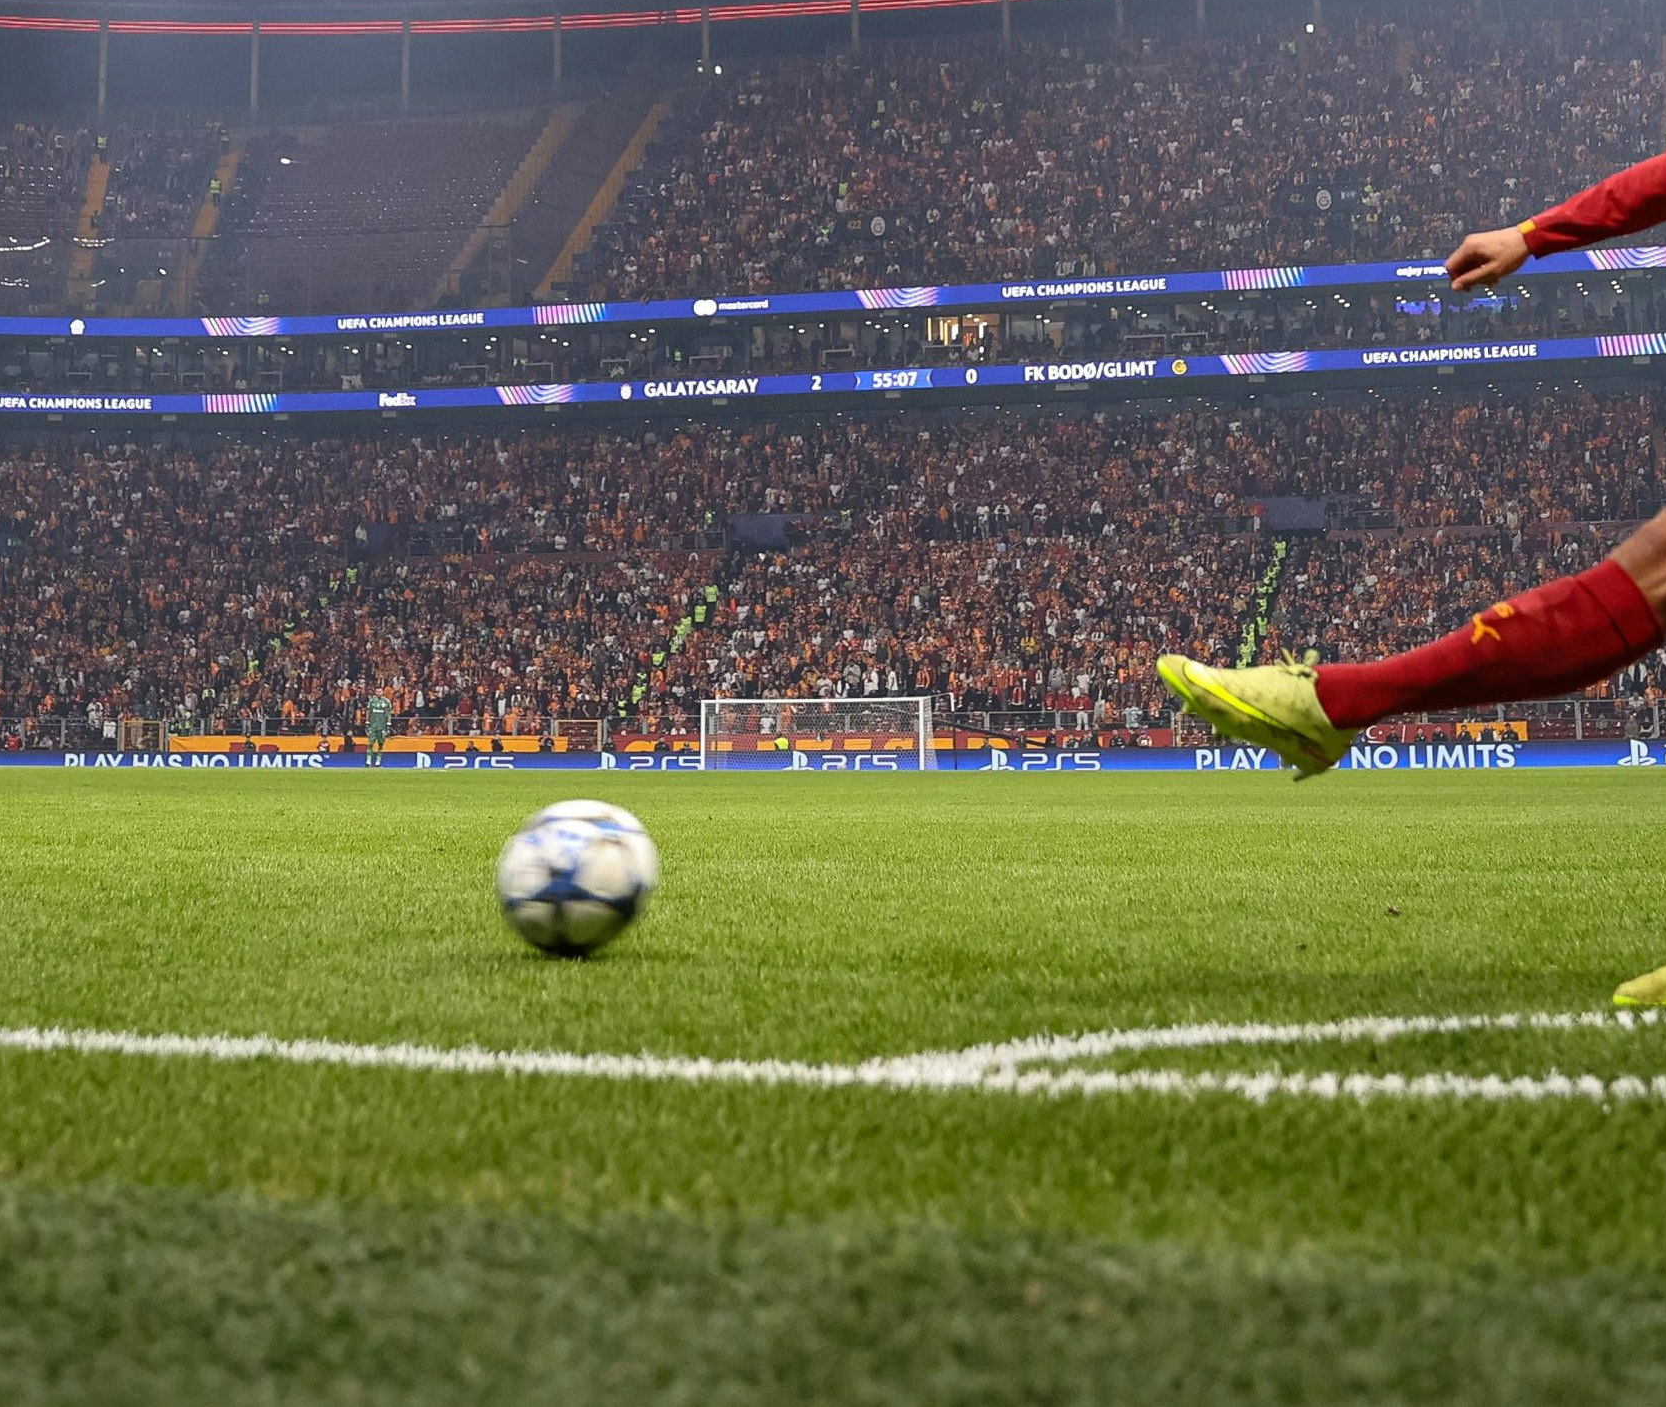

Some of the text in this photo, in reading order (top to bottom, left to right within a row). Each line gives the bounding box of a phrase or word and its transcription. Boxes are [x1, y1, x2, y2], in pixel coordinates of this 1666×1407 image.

[1002, 278, 1166, 298] UEFA CHAMPIONS LEAGUE
[337, 312, 484, 329] UEFA CHAMPIONS LEAGUE
[1363, 344, 1537, 365] UEFA CHAMPIONS LEAGUE
[644, 378, 758, 397] GALATASARAY
[811, 376, 821, 390] 2
[872, 372, 917, 388] 55:07
[965, 368, 977, 384] 0
[1024, 365, 1045, 381] FK
[29, 397, 102, 409] CHAMPIONS
[104, 398, 151, 409] LEAGUE
[379, 393, 416, 407] FedEx
[64, 753, 124, 767] PLAY
[133, 753, 183, 768] HAS
[822, 755, 897, 770] PS5
[1022, 753, 1101, 770] PS5
[1196, 748, 1266, 770] PLAY
[1351, 746, 1398, 769] NO
